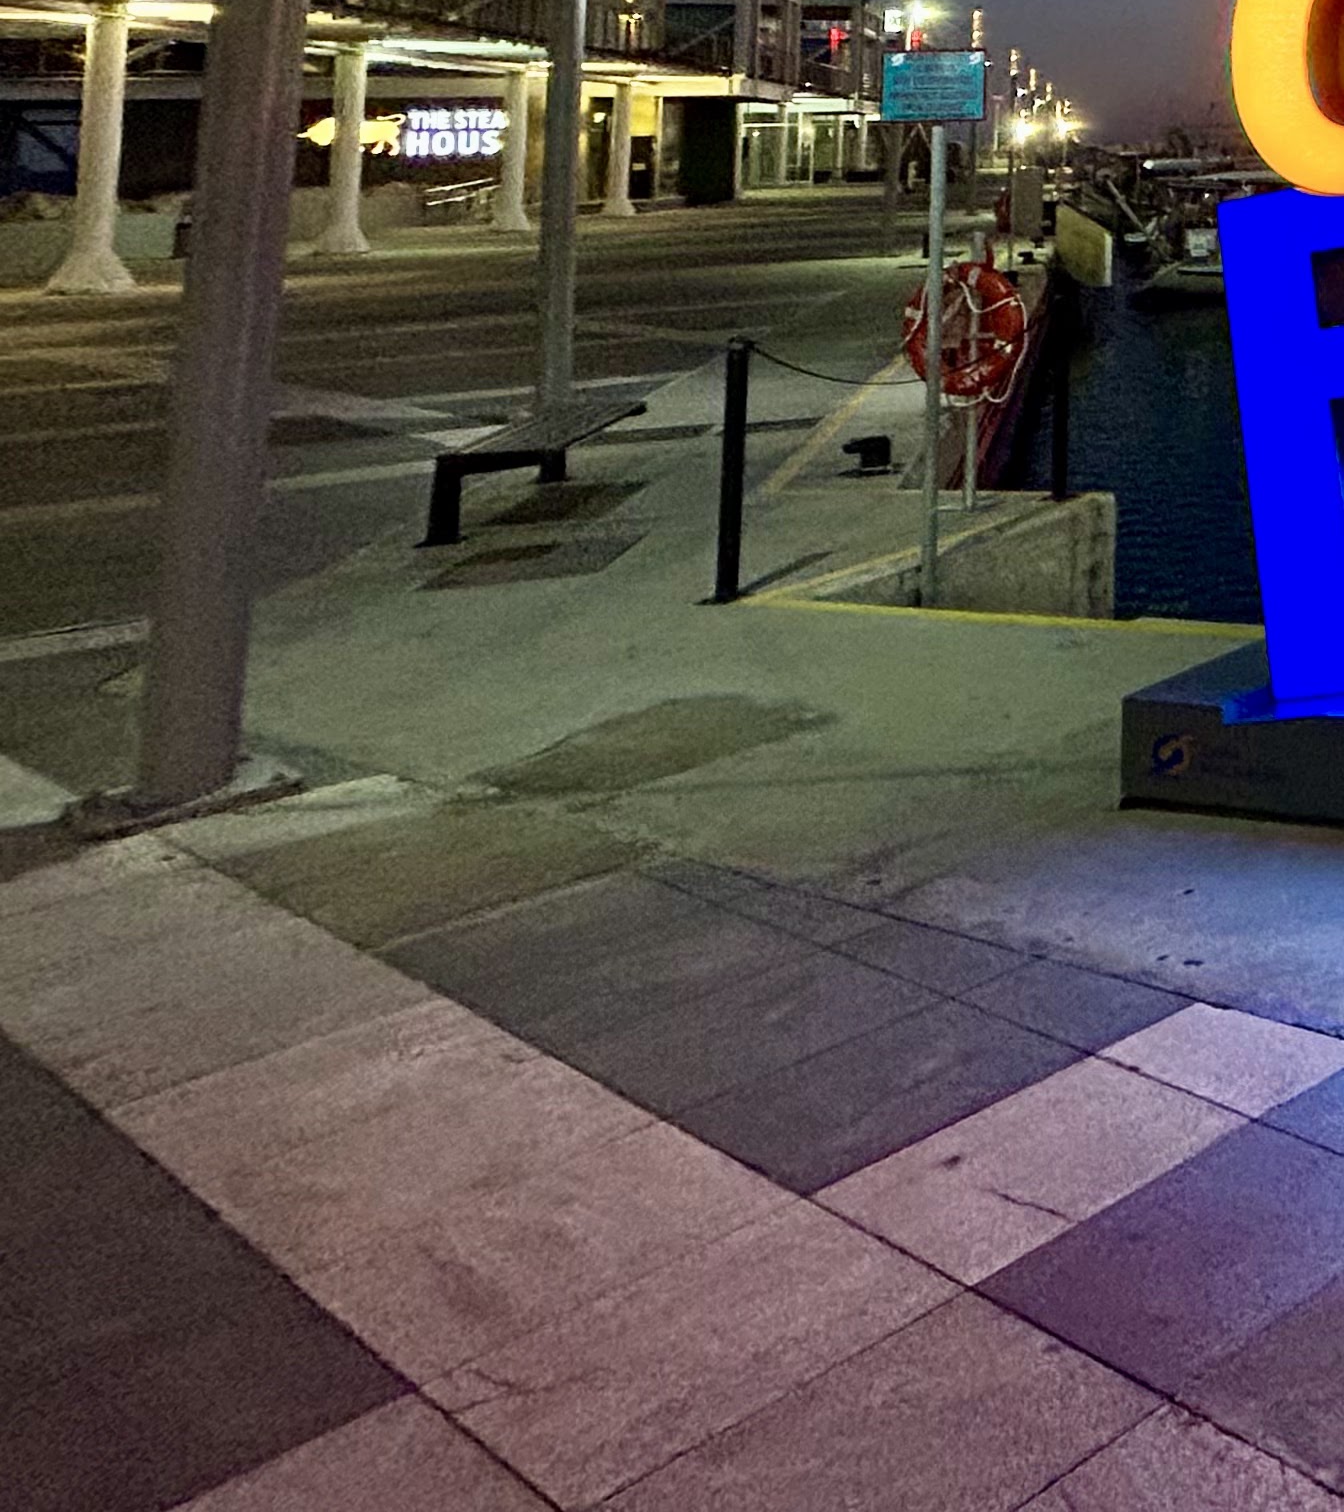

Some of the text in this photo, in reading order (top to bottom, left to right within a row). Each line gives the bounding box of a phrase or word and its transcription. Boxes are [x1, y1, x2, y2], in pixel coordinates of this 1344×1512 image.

[407, 108, 508, 129] THE STEA
[405, 130, 504, 157] HOUS
